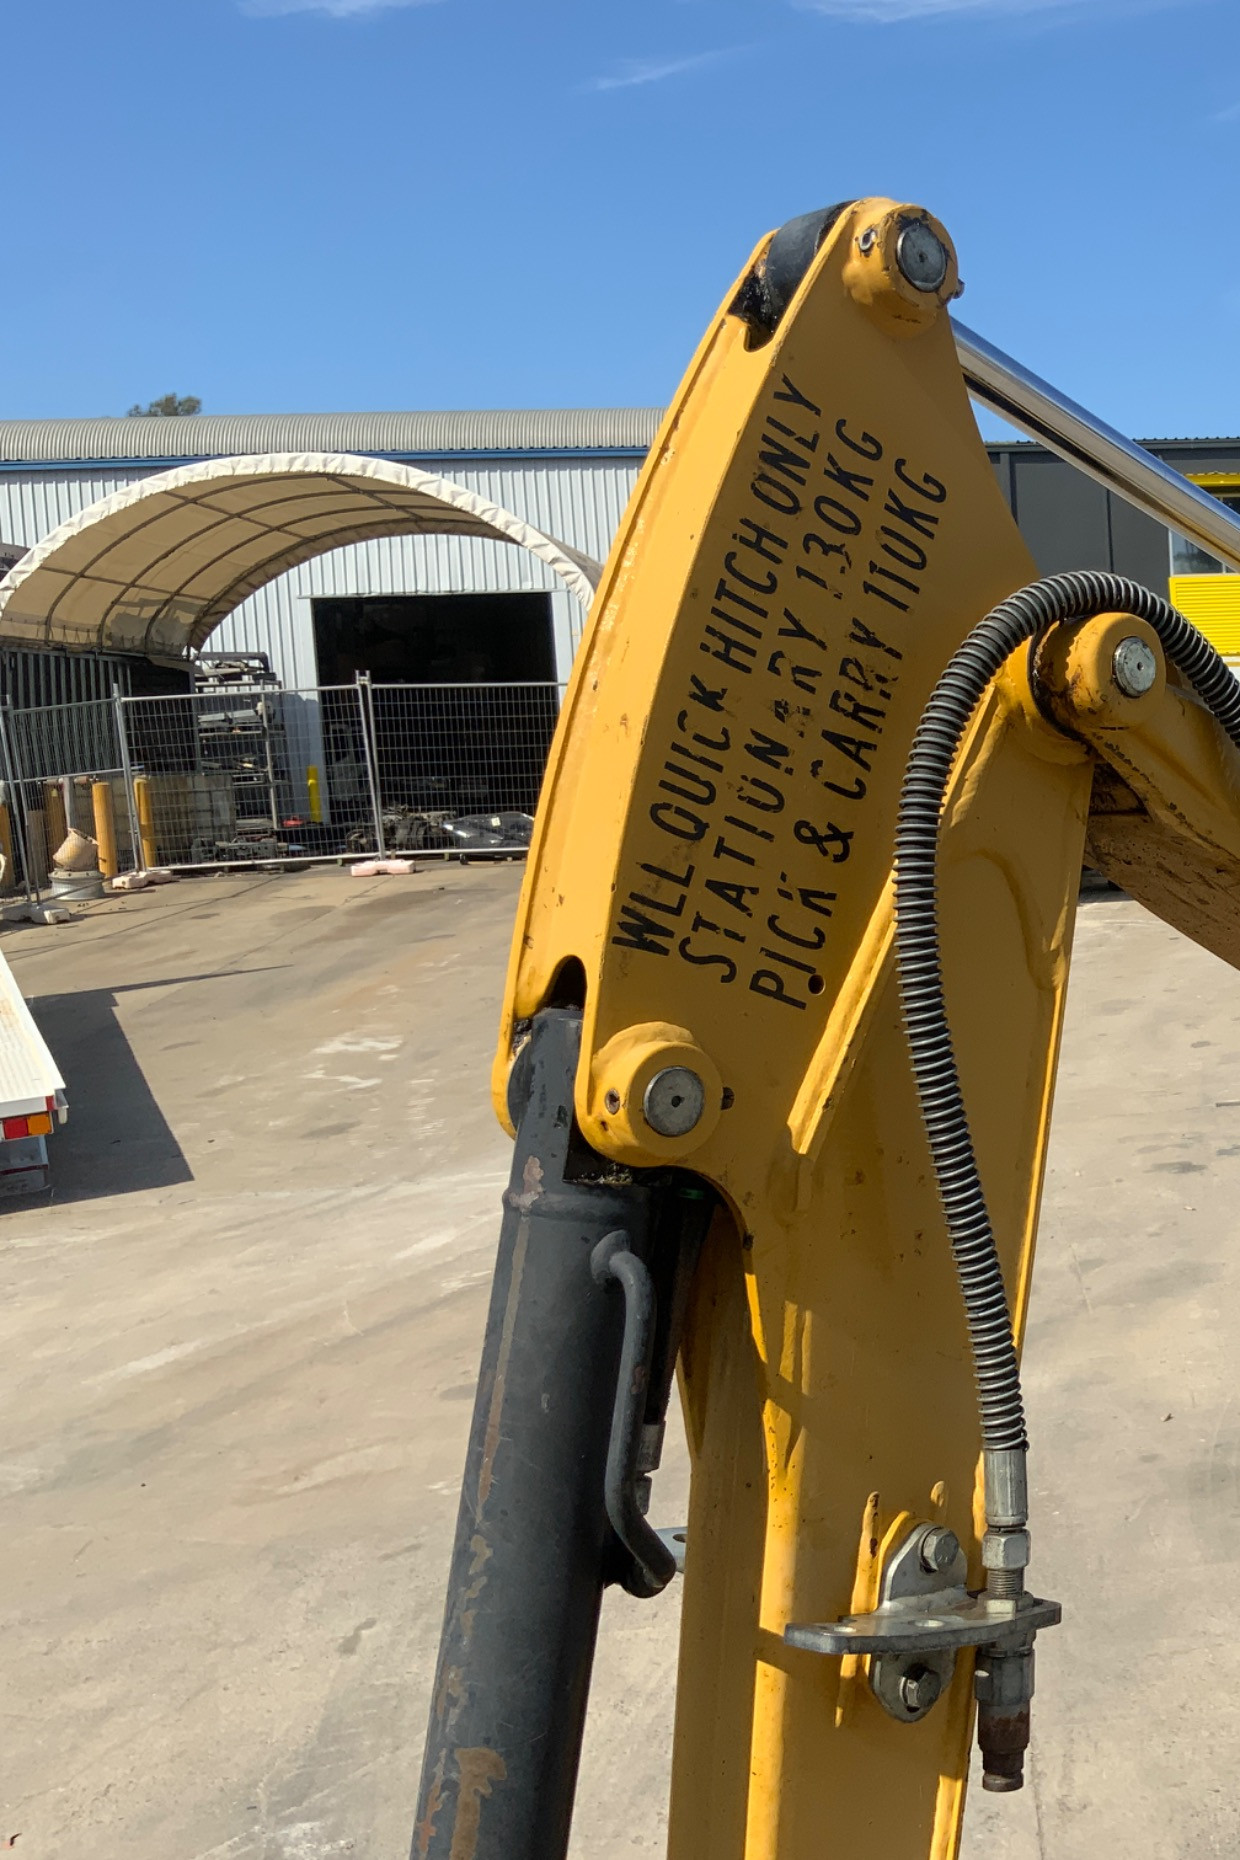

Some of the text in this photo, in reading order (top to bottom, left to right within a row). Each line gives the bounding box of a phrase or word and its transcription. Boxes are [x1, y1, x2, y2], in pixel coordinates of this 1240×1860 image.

[612, 373, 822, 957] WLL QUICK HITCH ONLY
[749, 458, 947, 1010] PICK & CARRY 110KG
[796, 418, 883, 600] 130KG
